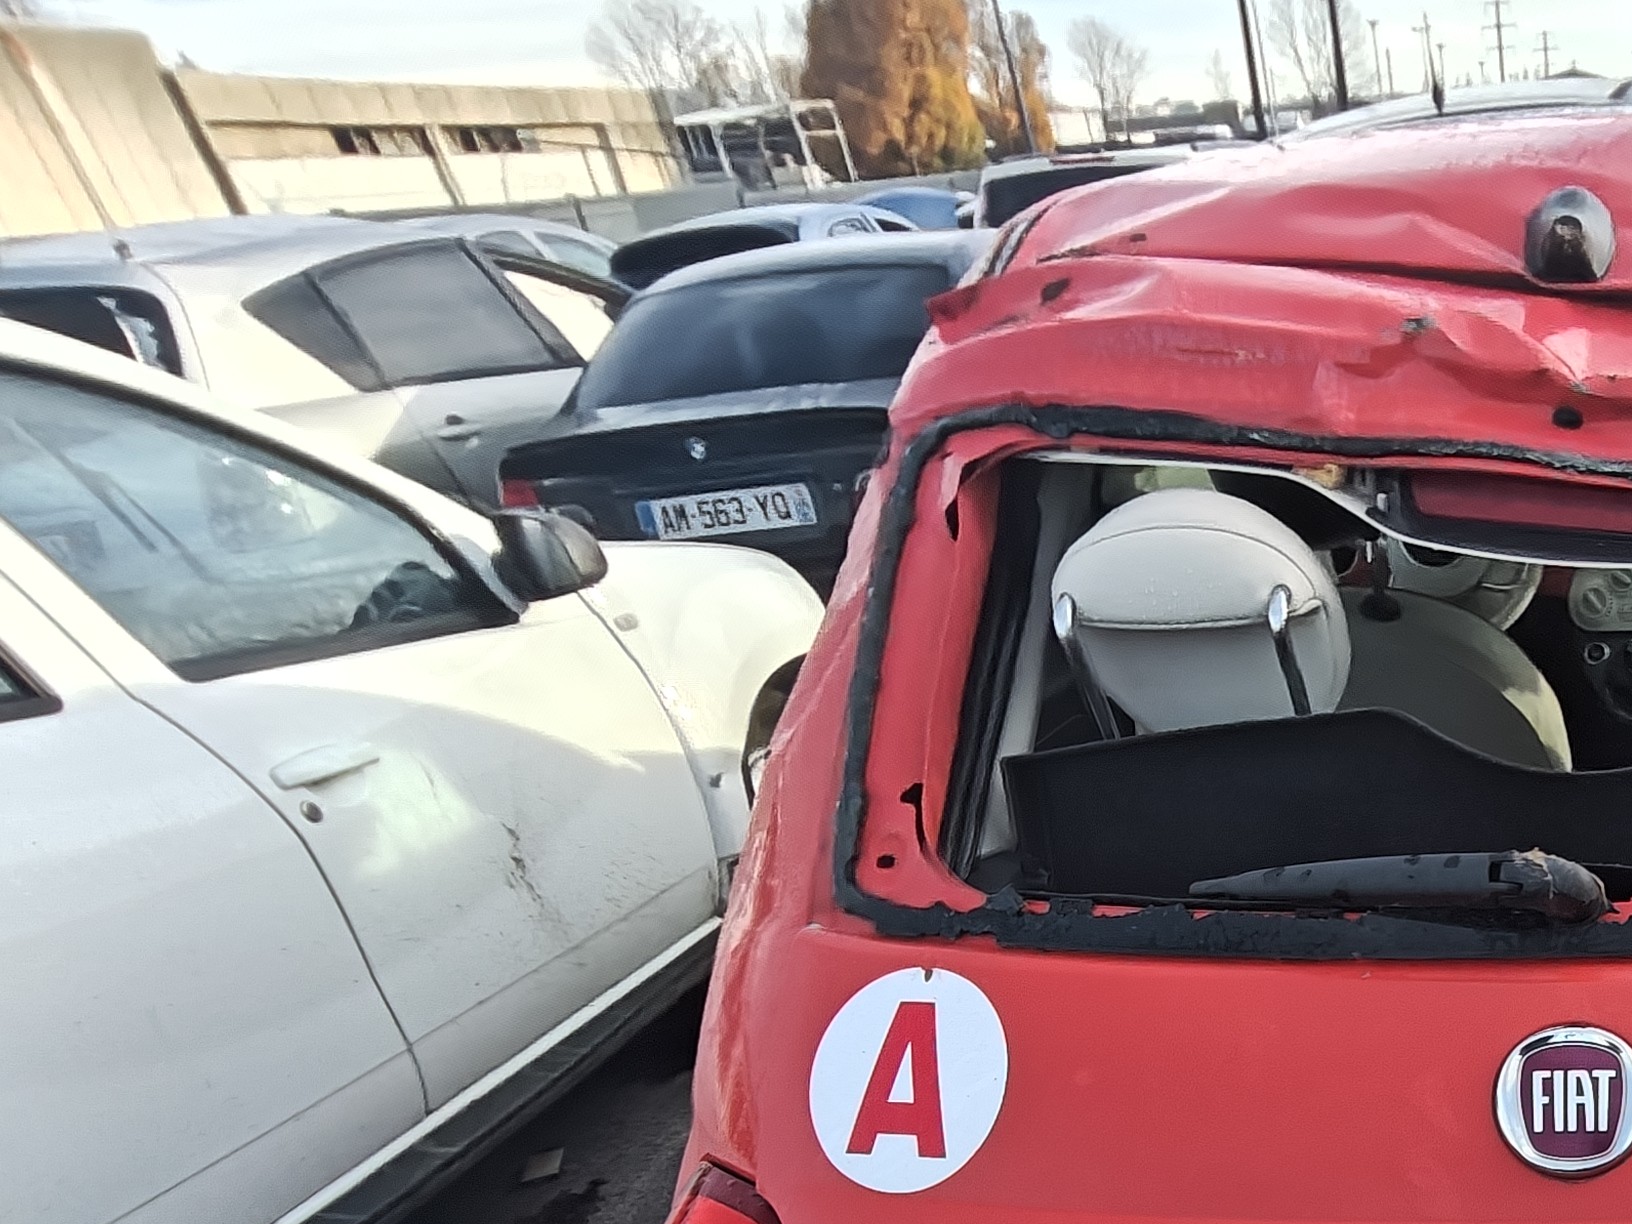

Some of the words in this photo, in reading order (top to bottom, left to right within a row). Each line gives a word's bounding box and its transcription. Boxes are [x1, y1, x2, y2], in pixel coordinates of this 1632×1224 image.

[660, 492, 793, 533] AM-563-YQ
[846, 1001, 947, 1159] A
[1532, 1069, 1616, 1133] FIAT
